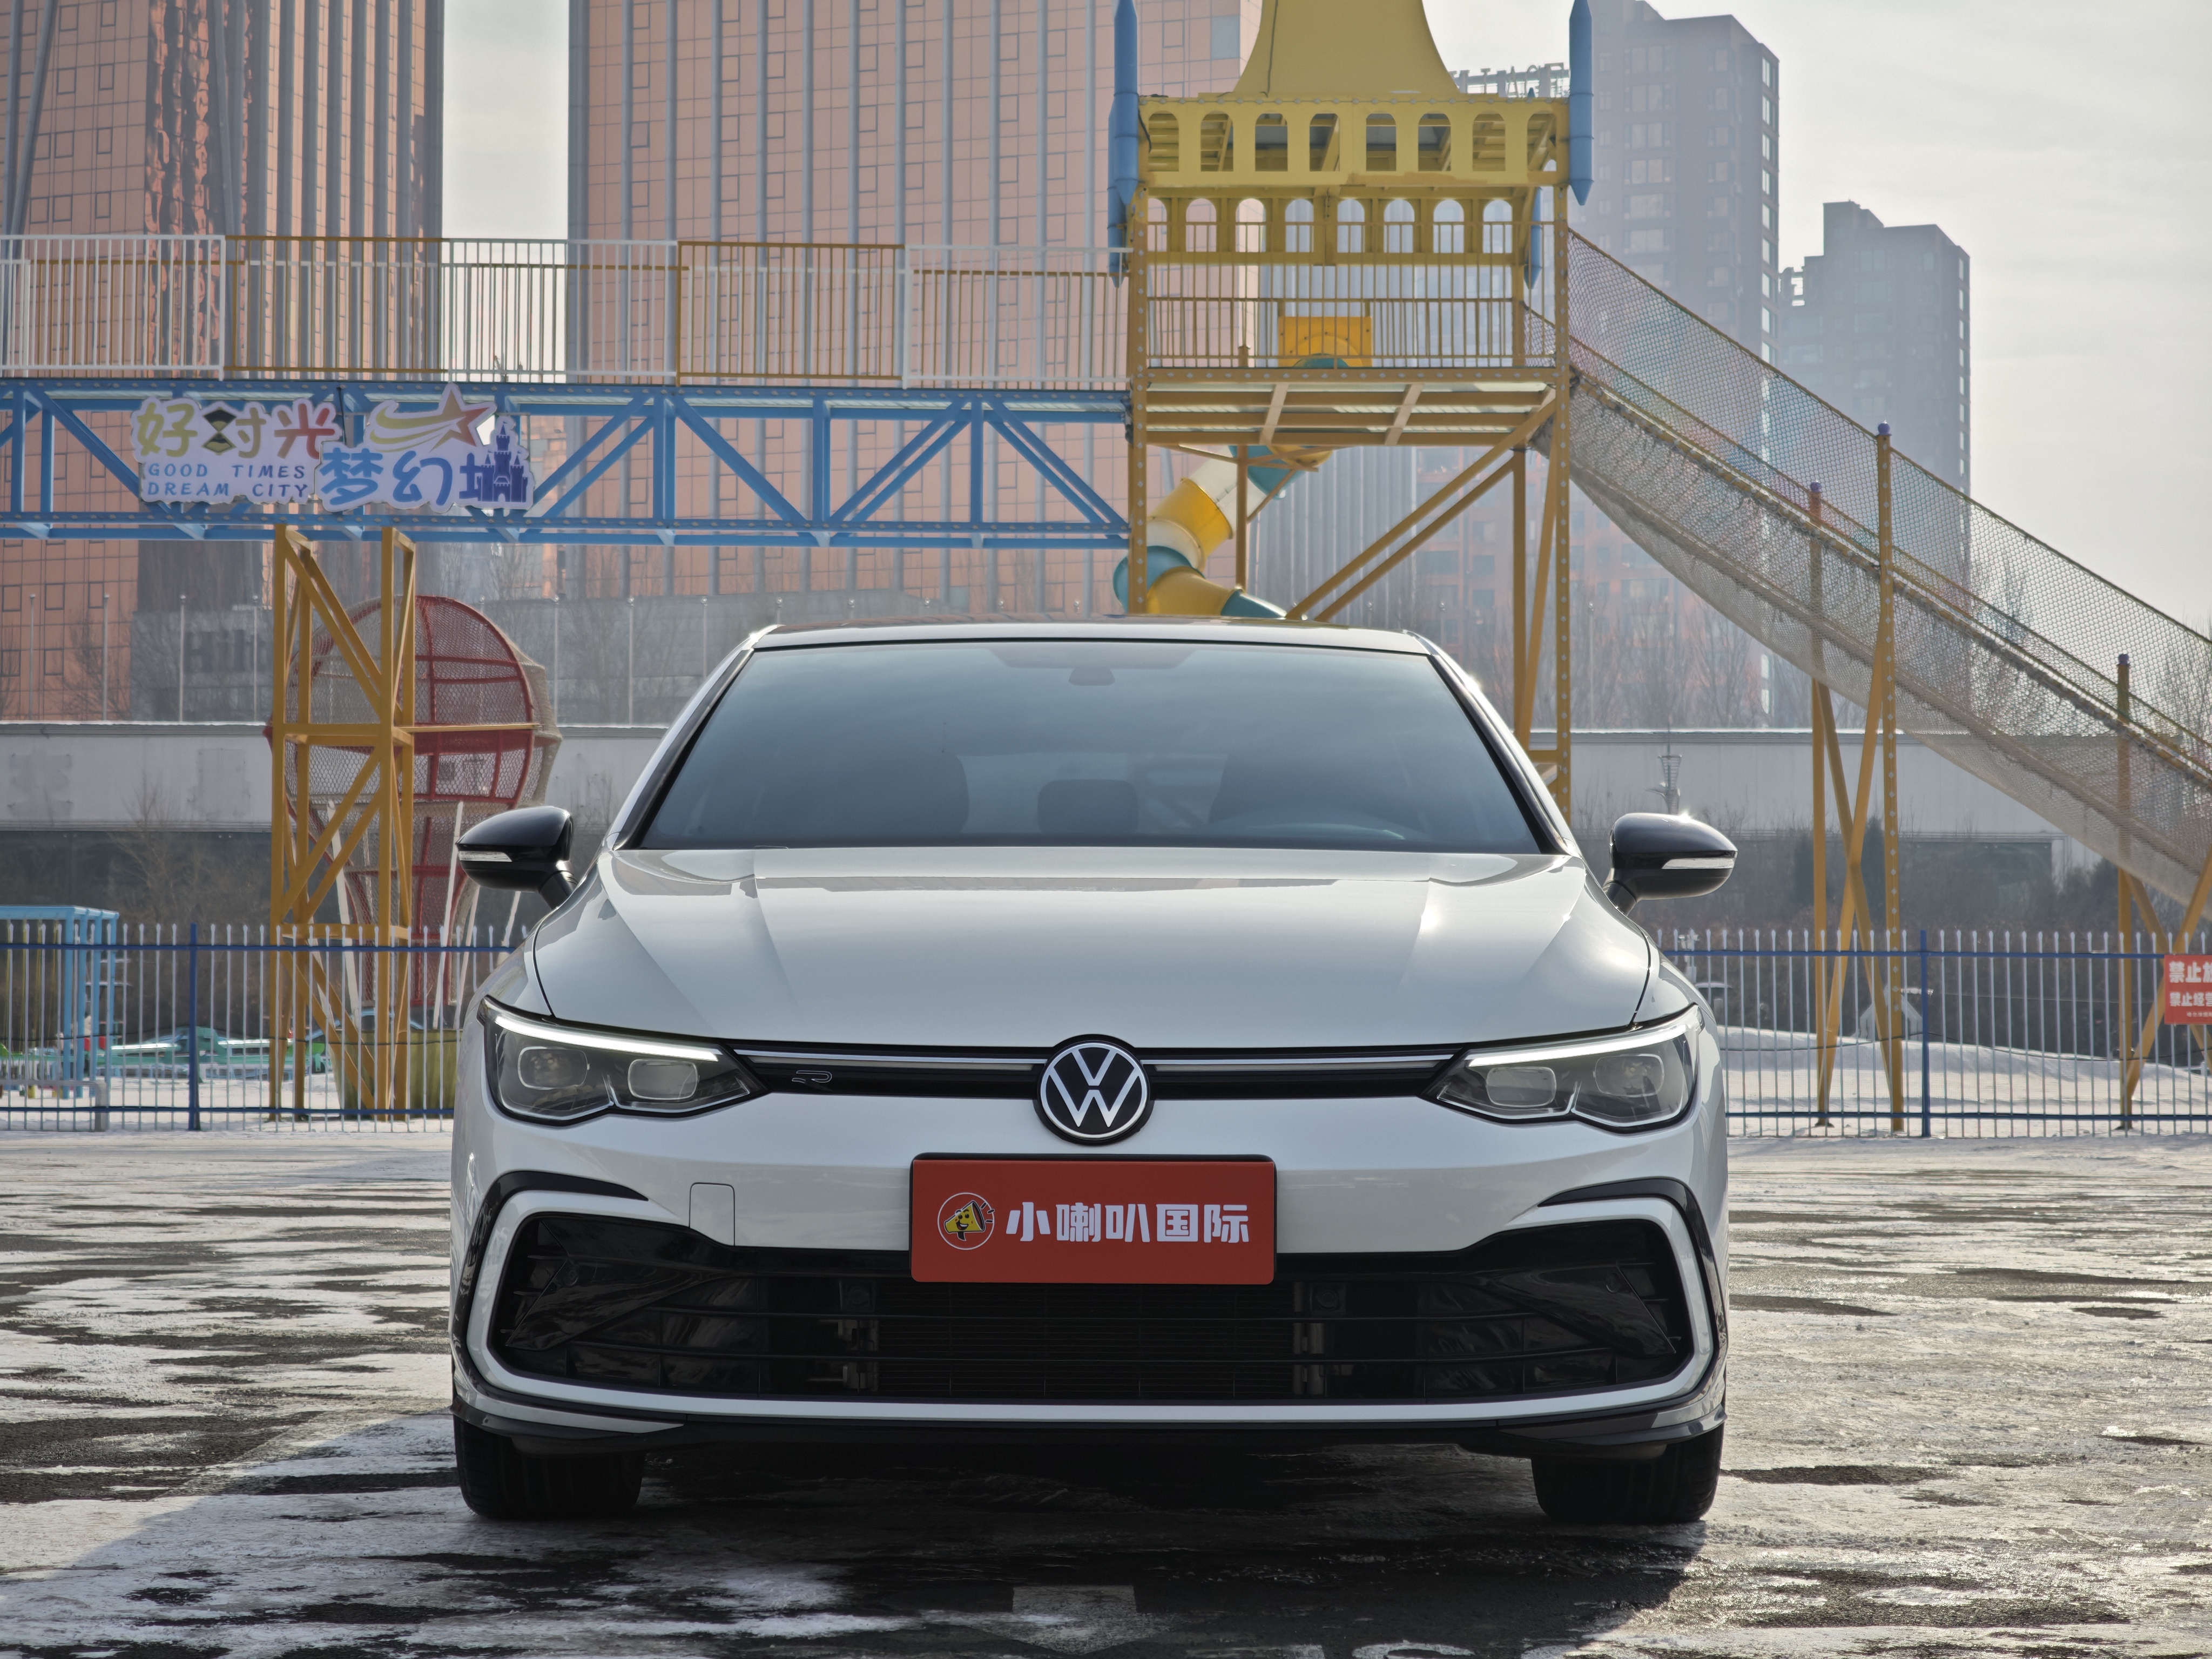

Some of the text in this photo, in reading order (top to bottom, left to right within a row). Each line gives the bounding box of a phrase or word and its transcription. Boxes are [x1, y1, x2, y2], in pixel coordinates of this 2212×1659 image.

[148, 463, 306, 479] GOOD TIMES
[147, 482, 308, 497] DREAM CITY
[1005, 1202, 1250, 1243] 小喇叭国际
